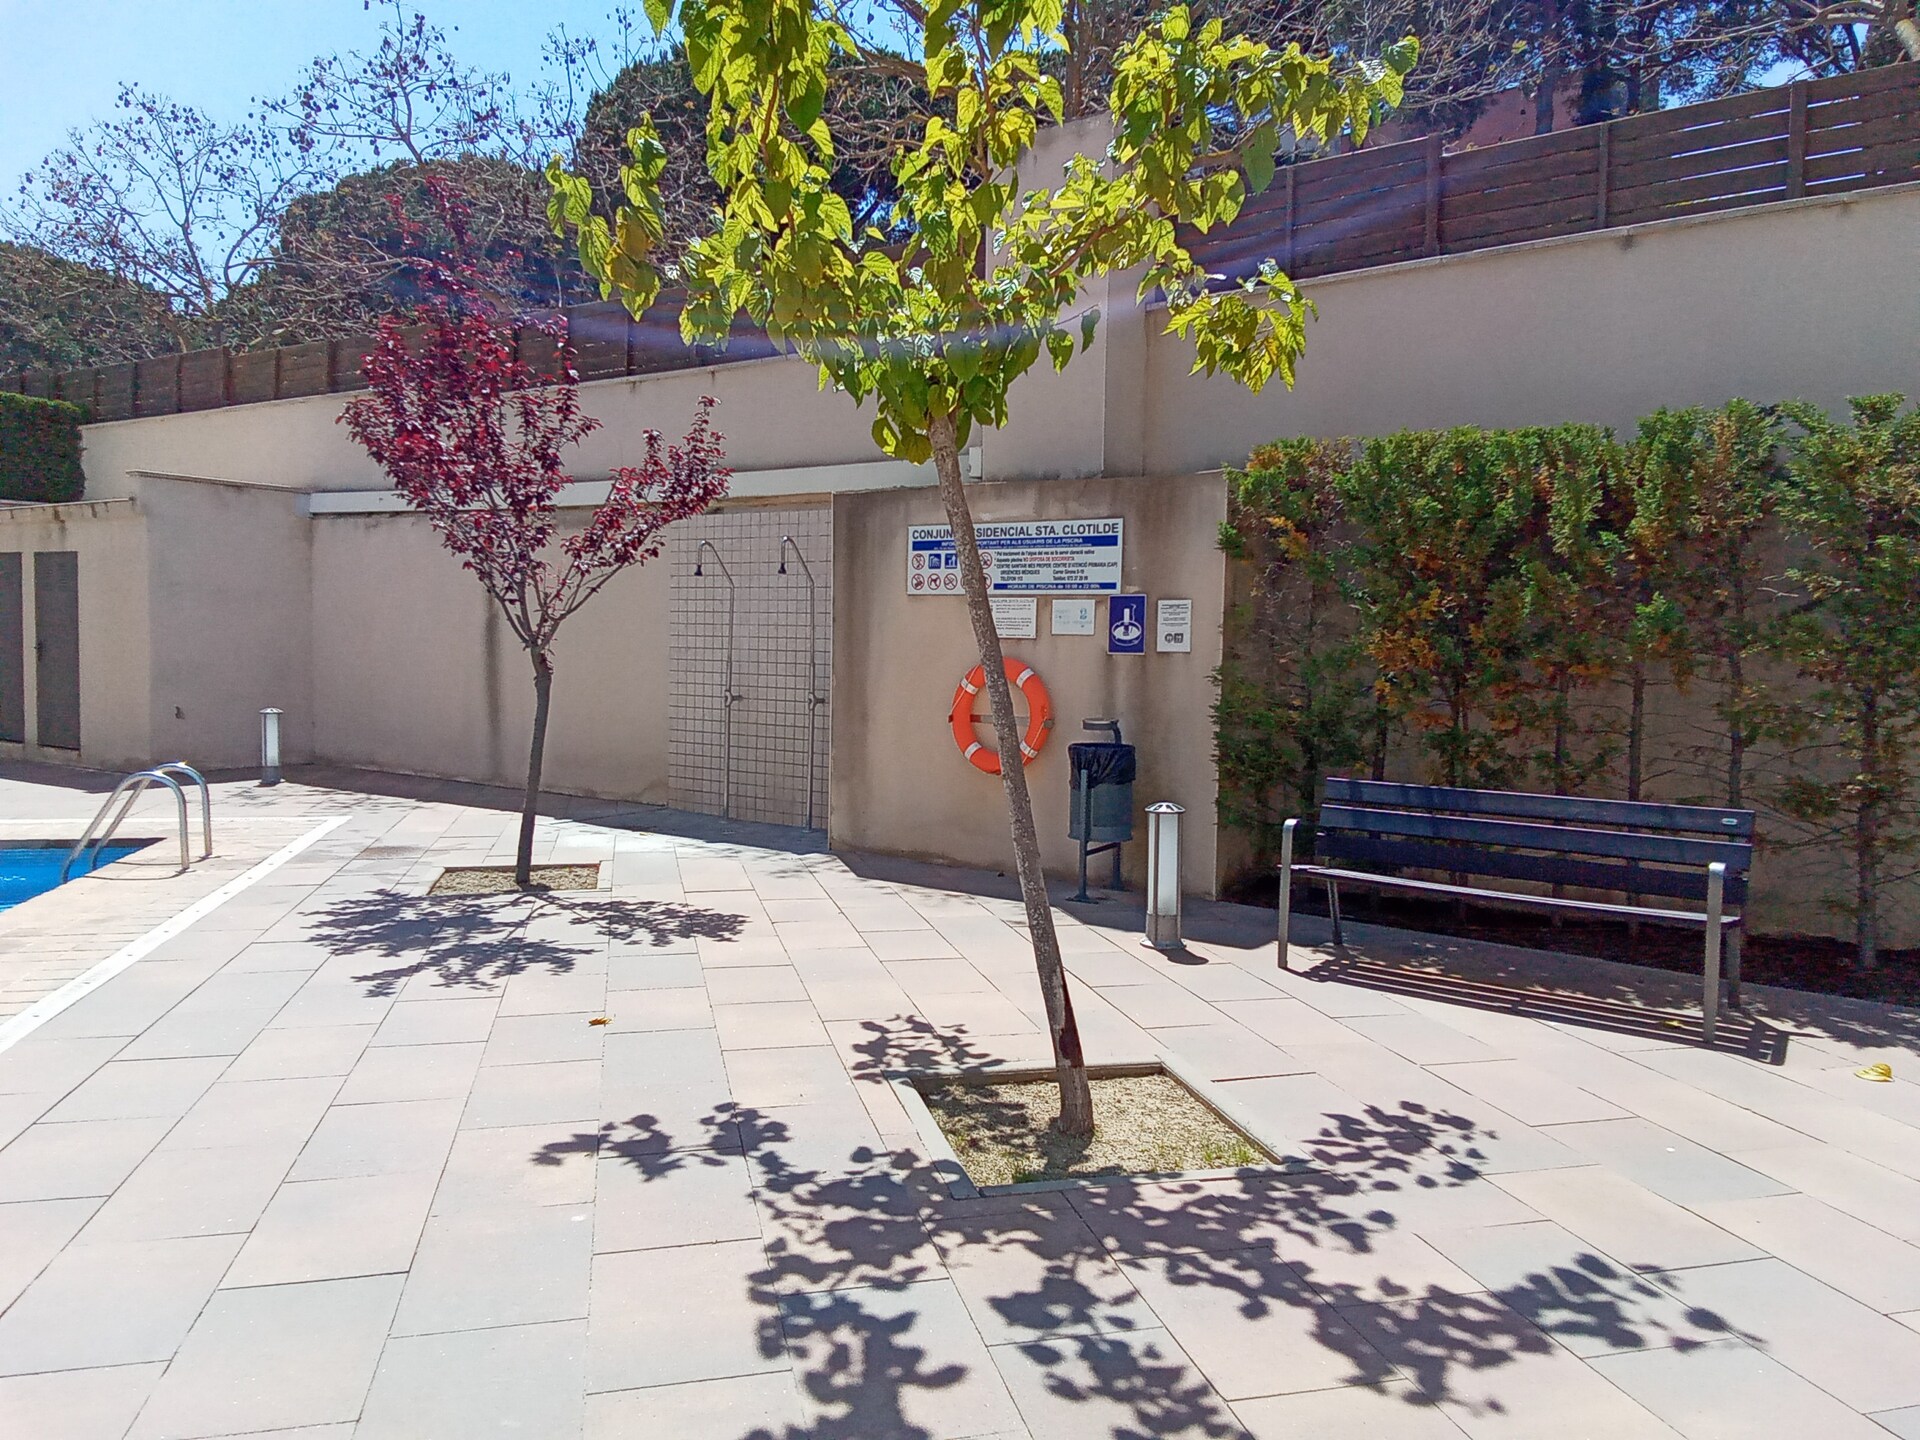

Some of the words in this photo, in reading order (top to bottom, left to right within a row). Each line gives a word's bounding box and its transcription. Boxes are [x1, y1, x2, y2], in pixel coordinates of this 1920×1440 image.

[912, 529, 954, 540] CONJUN
[976, 526, 1032, 538] SIDENCIAL
[1035, 526, 1060, 536] STA.
[1062, 523, 1119, 534] CLOTILDE
